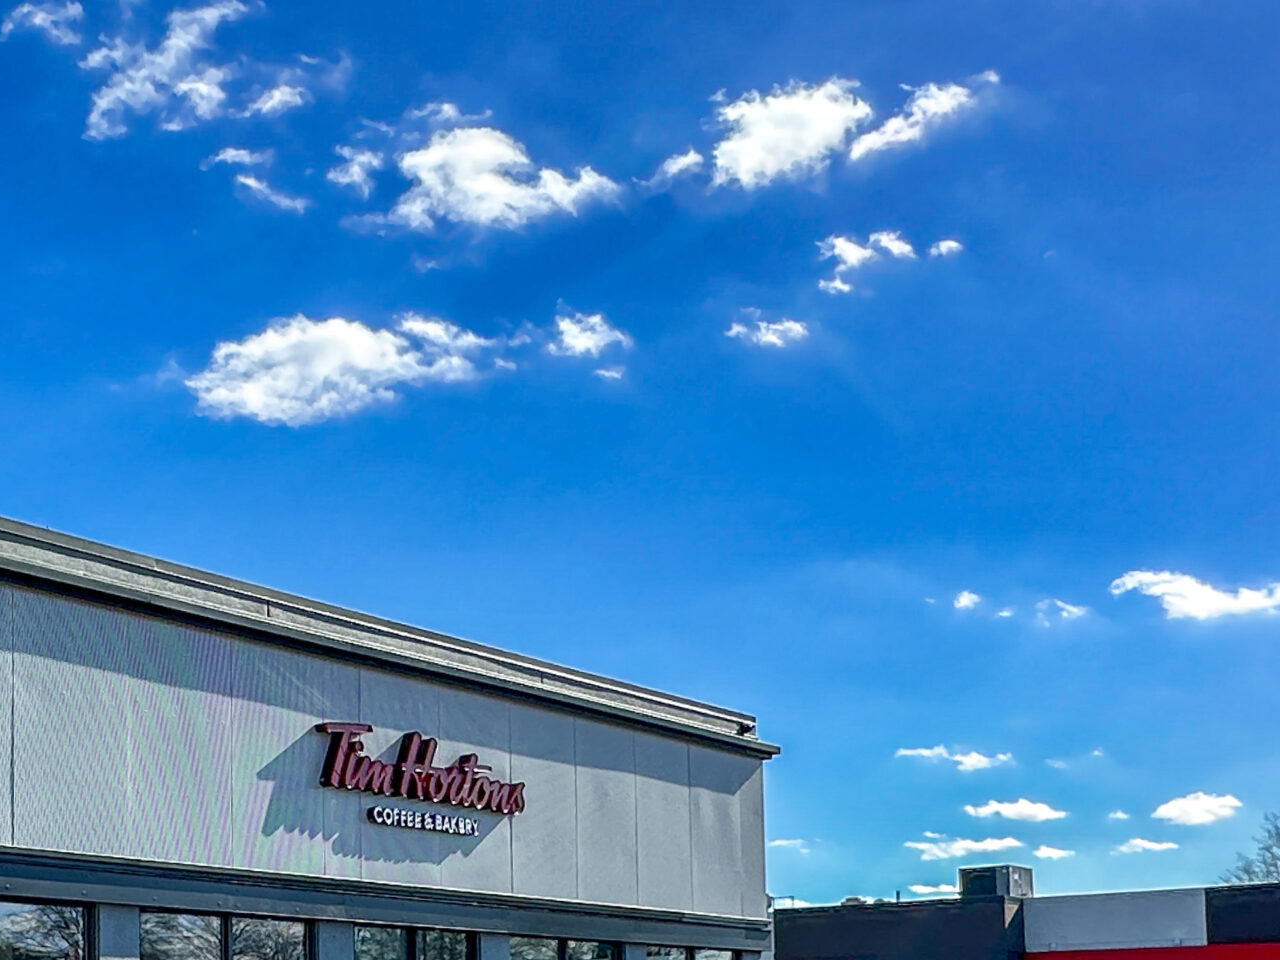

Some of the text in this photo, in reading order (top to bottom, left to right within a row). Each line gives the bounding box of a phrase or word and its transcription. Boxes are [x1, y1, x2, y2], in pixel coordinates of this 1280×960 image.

[317, 722, 525, 815] Tim Hortons
[373, 806, 479, 837] COFFEE & BAKERY
